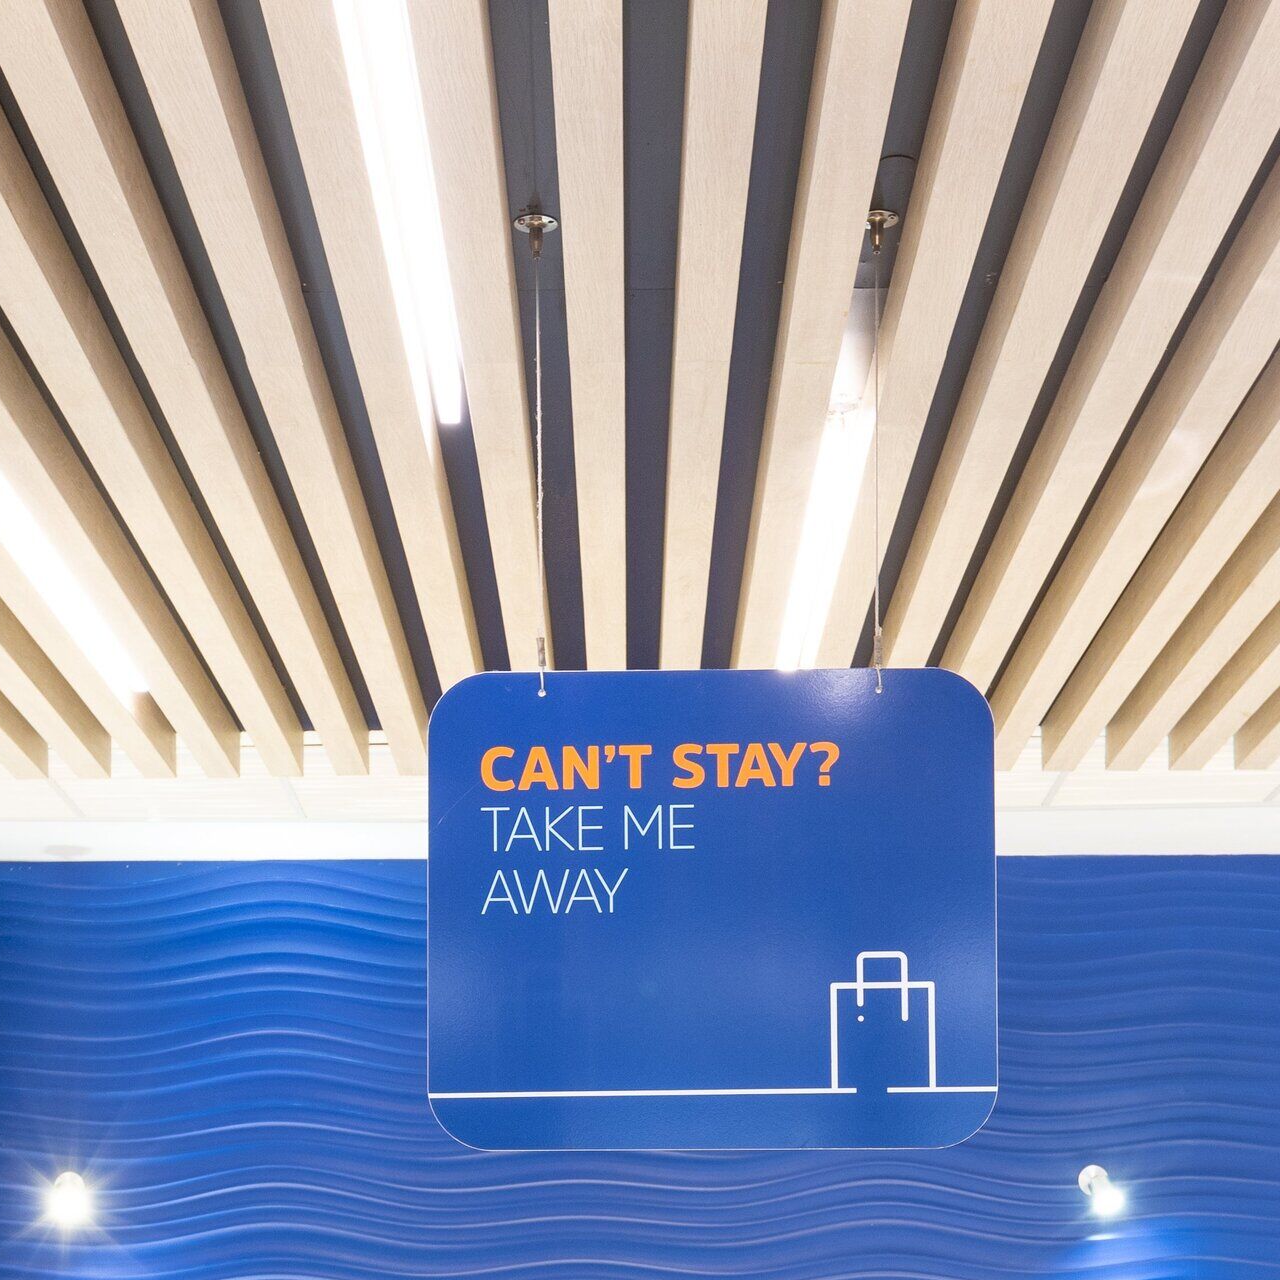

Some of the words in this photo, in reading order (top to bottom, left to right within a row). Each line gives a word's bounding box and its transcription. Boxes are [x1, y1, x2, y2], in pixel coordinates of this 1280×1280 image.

[672, 741, 840, 788] STAY?
[481, 805, 604, 852] TAKE
[623, 804, 695, 851] ME
[481, 867, 628, 915] AWAY
